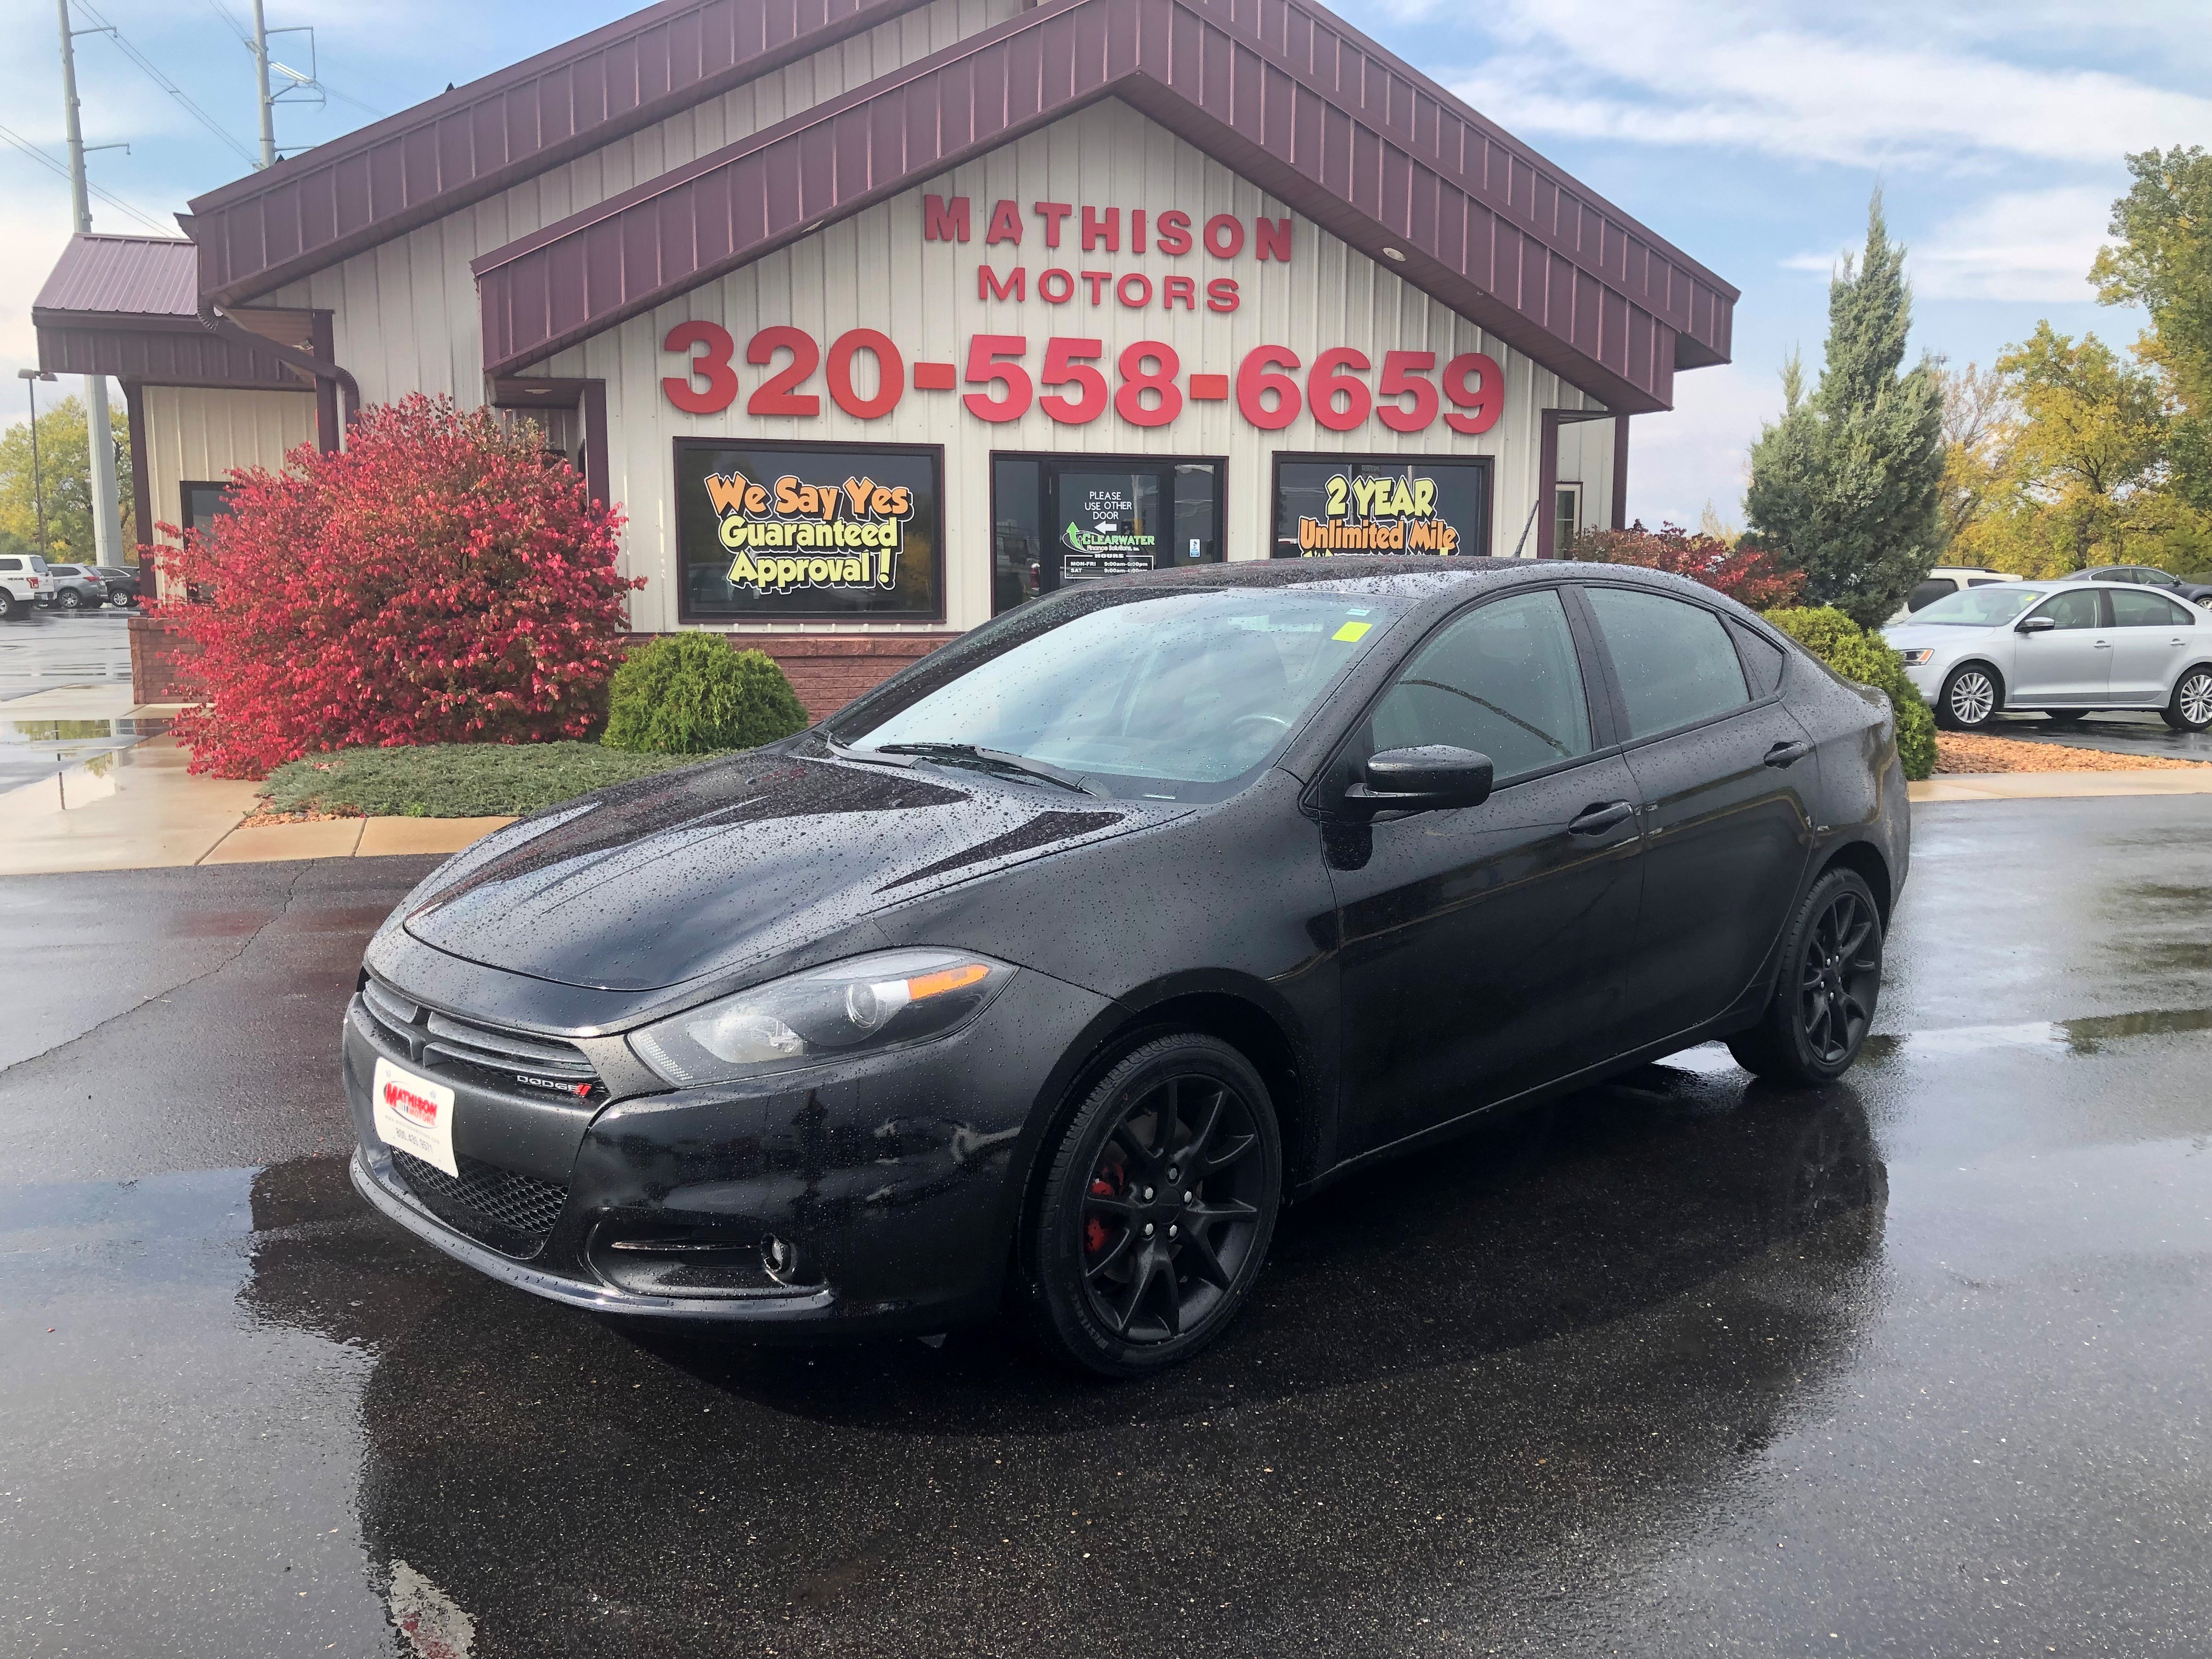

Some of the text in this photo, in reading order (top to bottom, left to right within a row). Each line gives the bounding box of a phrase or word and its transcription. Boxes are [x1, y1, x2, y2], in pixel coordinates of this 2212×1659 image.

[925, 195, 1292, 262] MATHISON
[979, 266, 1239, 312] MOTORS
[663, 320, 1505, 434] 320-558-6659
[706, 472, 909, 521] We Say Yes
[1085, 501, 1132, 511] USE OTHER
[1090, 491, 1121, 500] PLEASE
[1325, 476, 1435, 516] 2 YEAR
[720, 515, 899, 548] Guaranteed
[1093, 511, 1119, 520] DOOR
[1300, 519, 1456, 550] Unlimited Mile
[386, 1081, 437, 1119] MATHISON
[517, 1075, 582, 1093] DODGE
[409, 1107, 435, 1126] MOTORS
